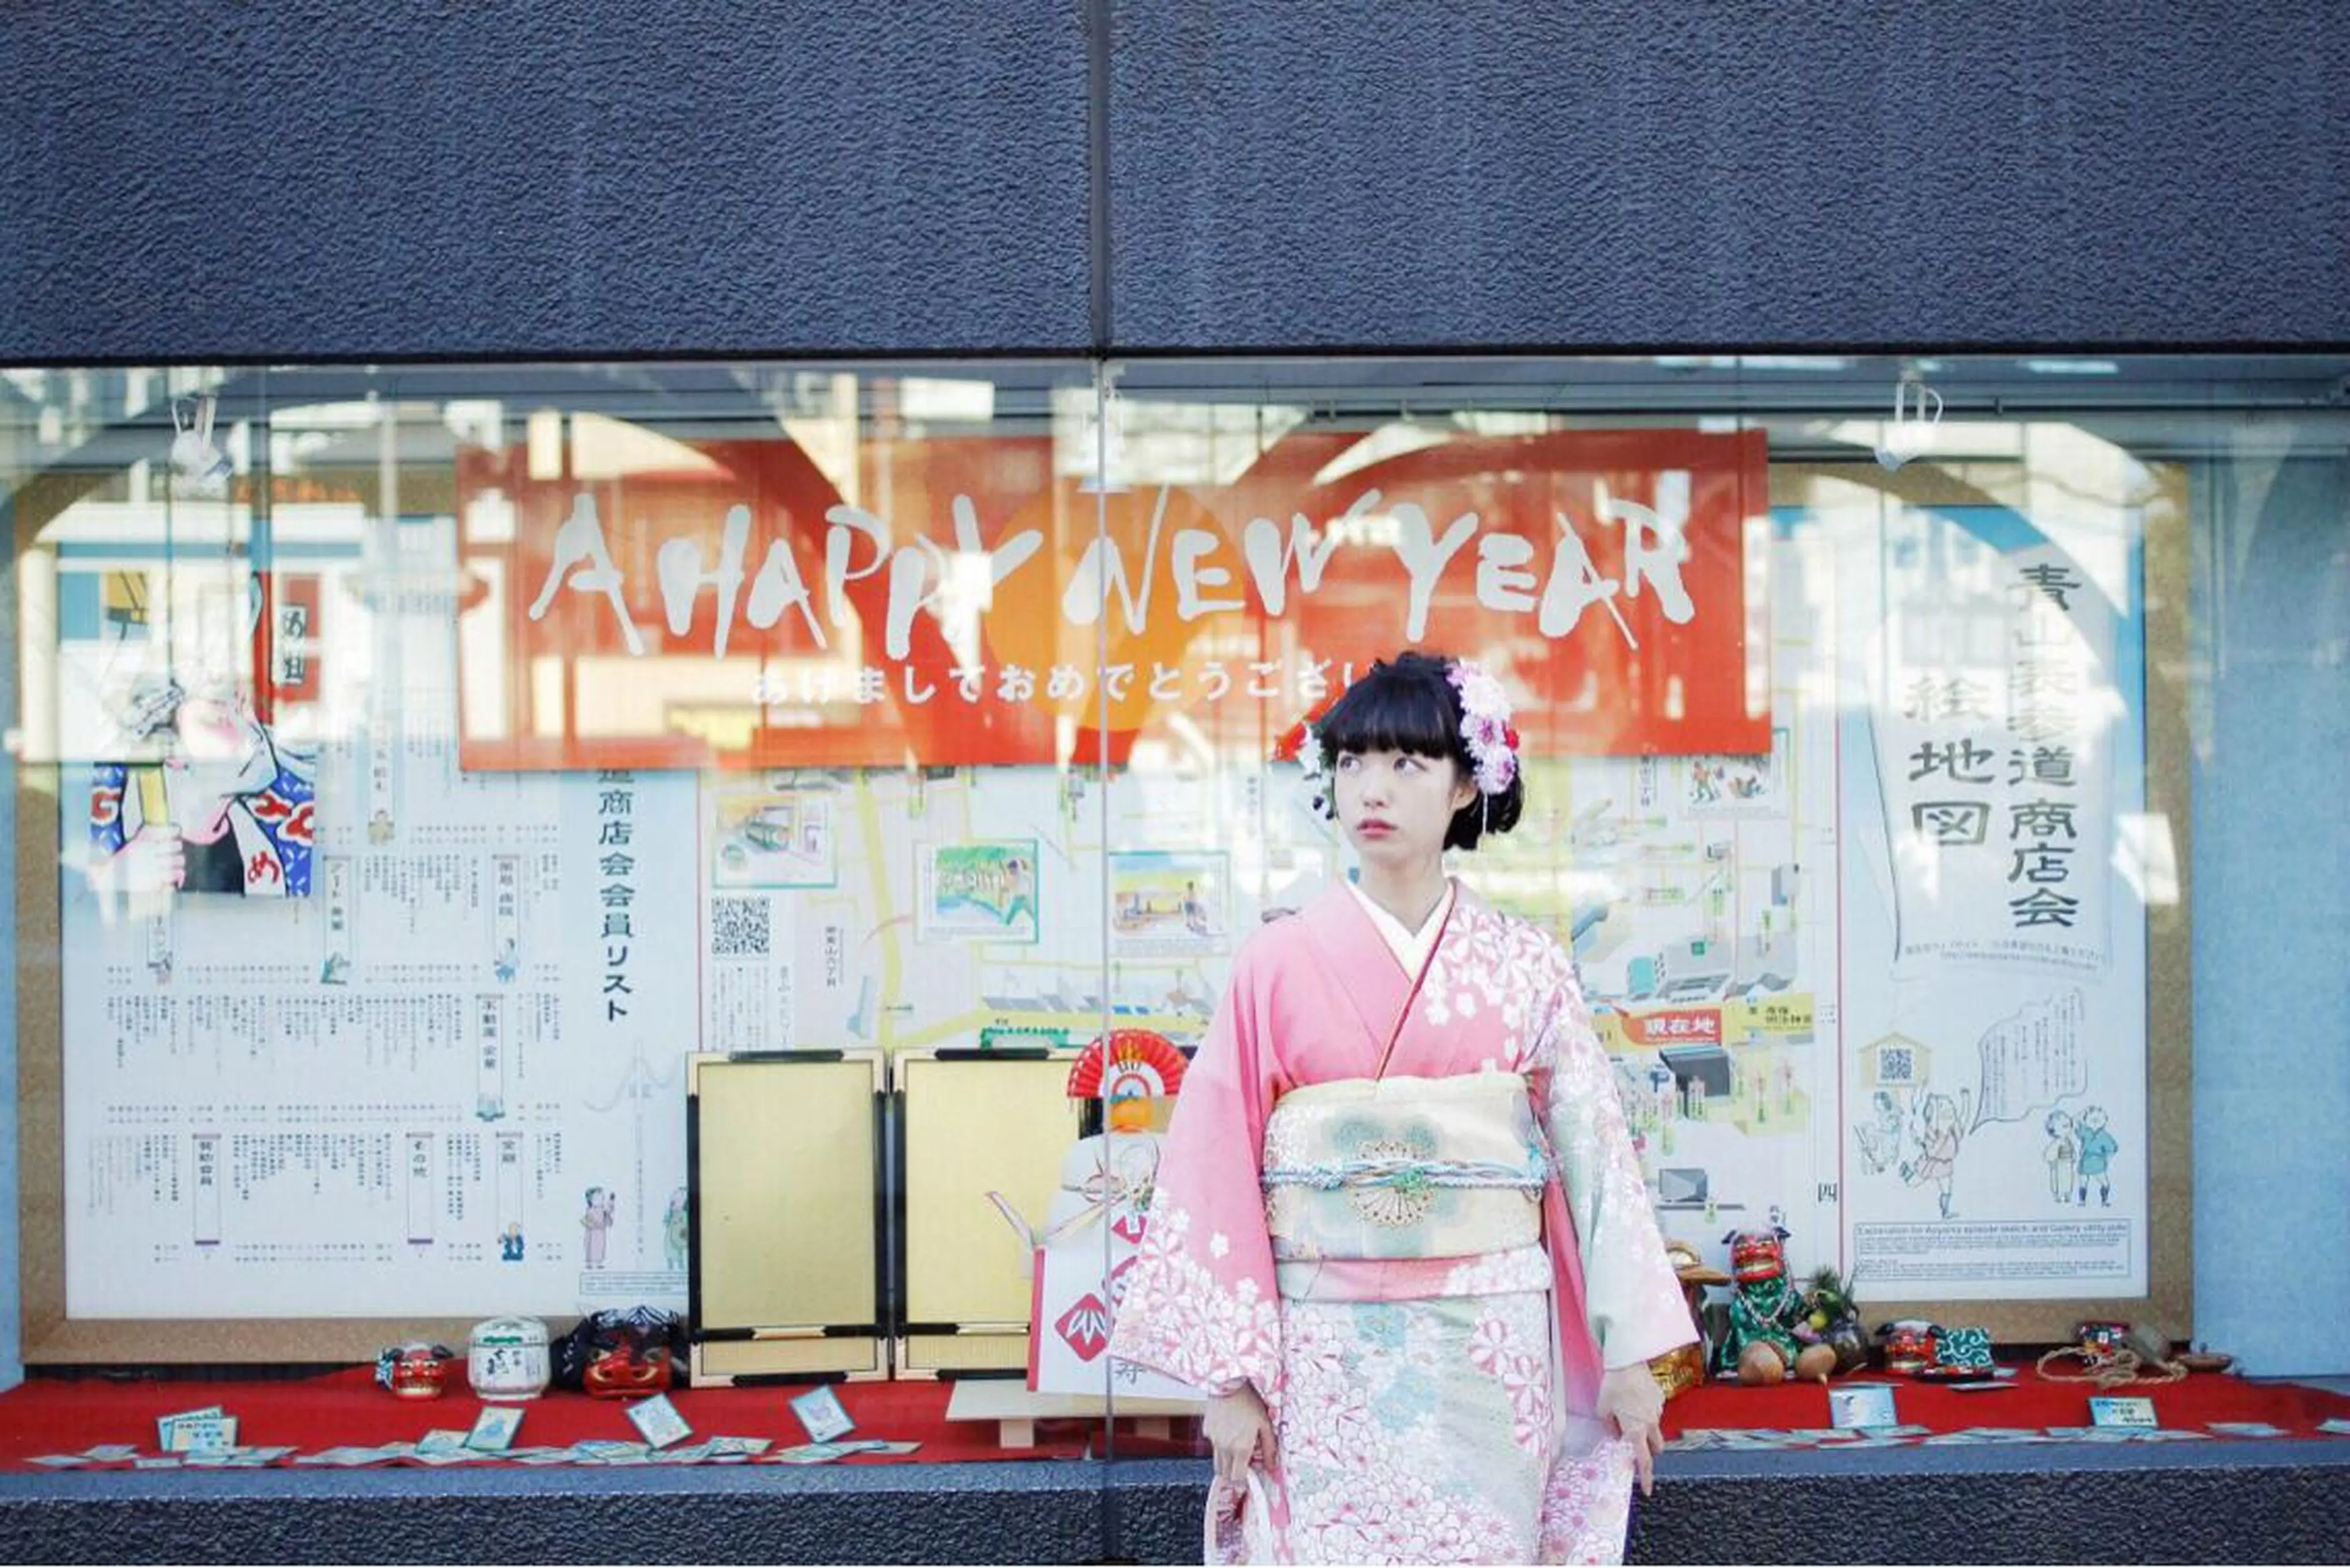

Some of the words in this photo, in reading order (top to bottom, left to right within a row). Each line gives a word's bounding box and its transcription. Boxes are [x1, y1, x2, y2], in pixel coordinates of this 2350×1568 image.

[529, 492, 645, 656] A
[657, 493, 1044, 660] HAPPY
[1061, 483, 1384, 635] NEW
[1386, 499, 1695, 649] YEAR
[1904, 676, 1995, 846] 絵地図
[1644, 1016, 1715, 1035] 現在地
